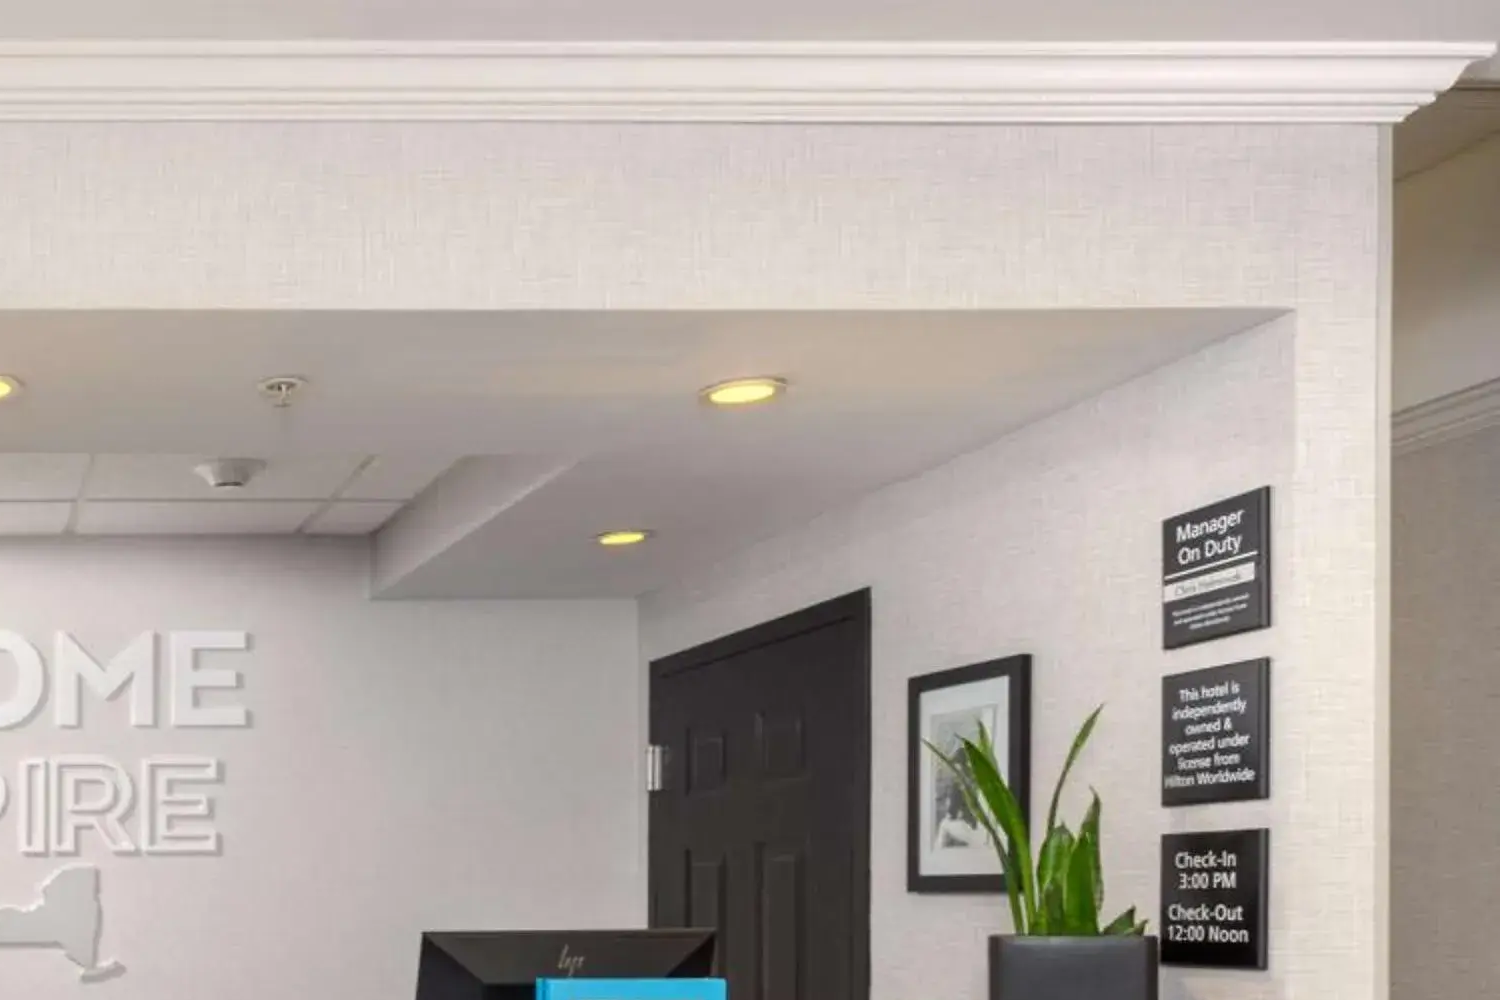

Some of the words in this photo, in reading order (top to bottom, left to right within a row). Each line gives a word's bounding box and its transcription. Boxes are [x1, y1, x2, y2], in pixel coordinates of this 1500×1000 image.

[1176, 510, 1245, 543] Manager
[1177, 547, 1200, 565] On
[1204, 535, 1242, 558] Duty
[1179, 687, 1199, 702] This
[1200, 681, 1229, 699] hotel
[1231, 680, 1240, 695] is
[1171, 697, 1247, 721] independently
[1185, 718, 1221, 736] owned
[1223, 716, 1233, 731] &
[1168, 737, 1215, 756] operated
[1217, 733, 1250, 749] under
[1177, 757, 1212, 771] license
[1213, 753, 1241, 767] from
[1163, 774, 1195, 789] Hilton
[1196, 767, 1256, 785] Worldwide
[1174, 850, 1237, 869] Check-In
[1179, 872, 1209, 889] 3:00
[1213, 871, 1237, 889] PM
[1168, 902, 1244, 921] Check-Out
[1168, 925, 1205, 942] 12:00
[1208, 925, 1250, 943] Noon
